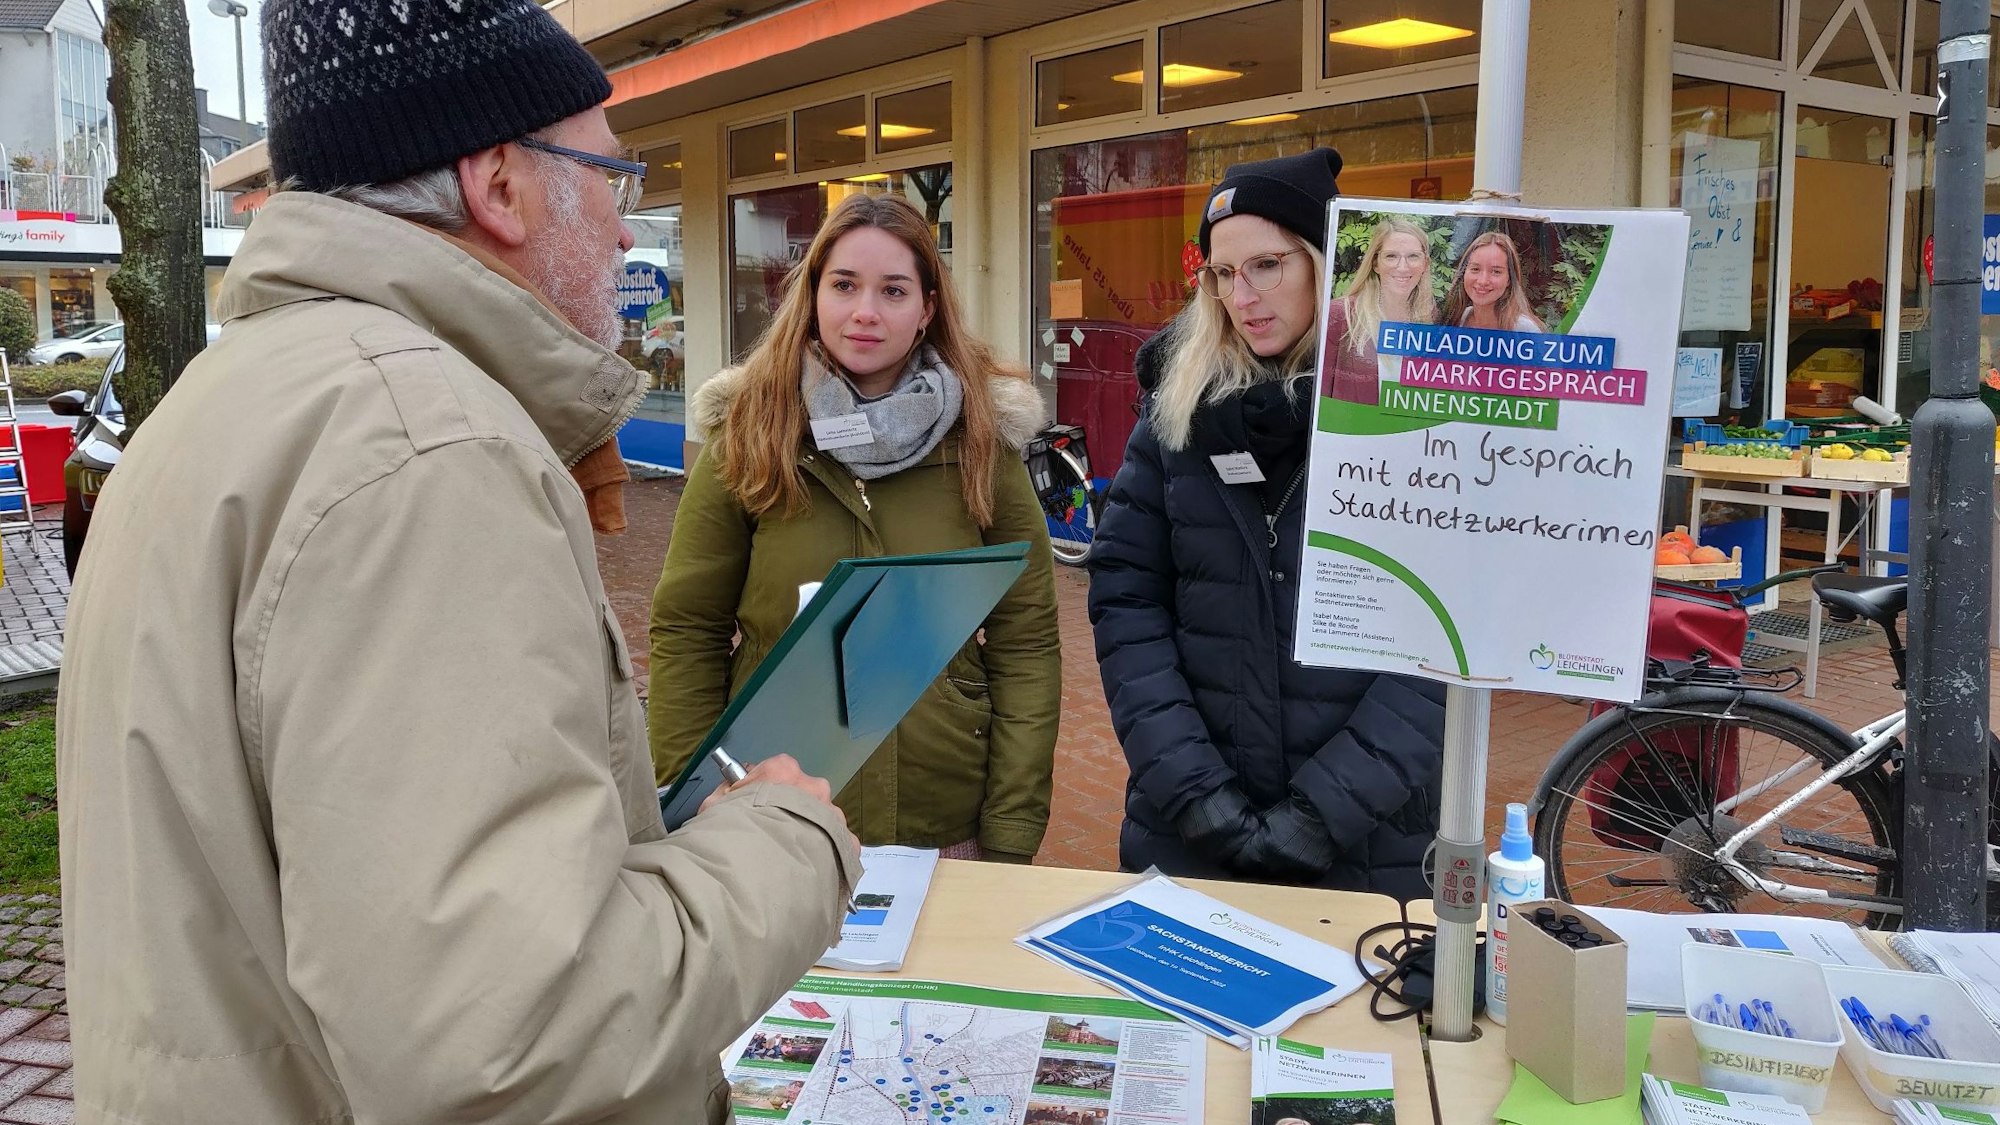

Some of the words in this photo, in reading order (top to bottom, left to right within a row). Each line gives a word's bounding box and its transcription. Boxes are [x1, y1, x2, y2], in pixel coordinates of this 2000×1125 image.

[1708, 196, 1731, 219] Obst
[25, 229, 65, 243] family
[1383, 328, 1535, 361] EINLADUNG
[1542, 341, 1604, 366] ZUM
[1405, 360, 1636, 398] MARKTGESPRÄCH
[1384, 388, 1550, 423] INNENSTADT
[1424, 429, 1458, 460] Im
[1475, 431, 1633, 486] Gespräch
[1338, 457, 1392, 487] mit
[1408, 467, 1461, 494] den
[1329, 489, 1655, 550] Stadtnetzwerkerinnen
[1329, 561, 1348, 569] haben
[1349, 565, 1371, 573] Fragen
[1333, 570, 1361, 578] möchten
[1376, 576, 1395, 584] gerne
[1316, 576, 1357, 586] informieren?
[1315, 590, 1355, 600] Kontaktieren
[1356, 594, 1366, 602] Sie
[1313, 612, 1332, 620] Isabel
[1333, 614, 1360, 623] Maniura
[1328, 628, 1360, 638] Lammertz
[1361, 632, 1395, 644] (Assistenz)
[1310, 642, 1430, 663] stadtnetzwerkerinnen@leichlingen.de
[1558, 653, 1604, 664] BLÜTENSTADT
[1557, 660, 1624, 676] LEICHLINGEN
[1147, 924, 1271, 978] SACHSTANDSBERICHT
[1178, 953, 1222, 974] Leichlingen
[837, 980, 910, 989] Handlungskonzept
[1278, 1060, 1367, 1080] NETZWERKERINNEN
[1279, 1055, 1309, 1065] STADT-
[1895, 1078, 1995, 1100] BENUTZT
